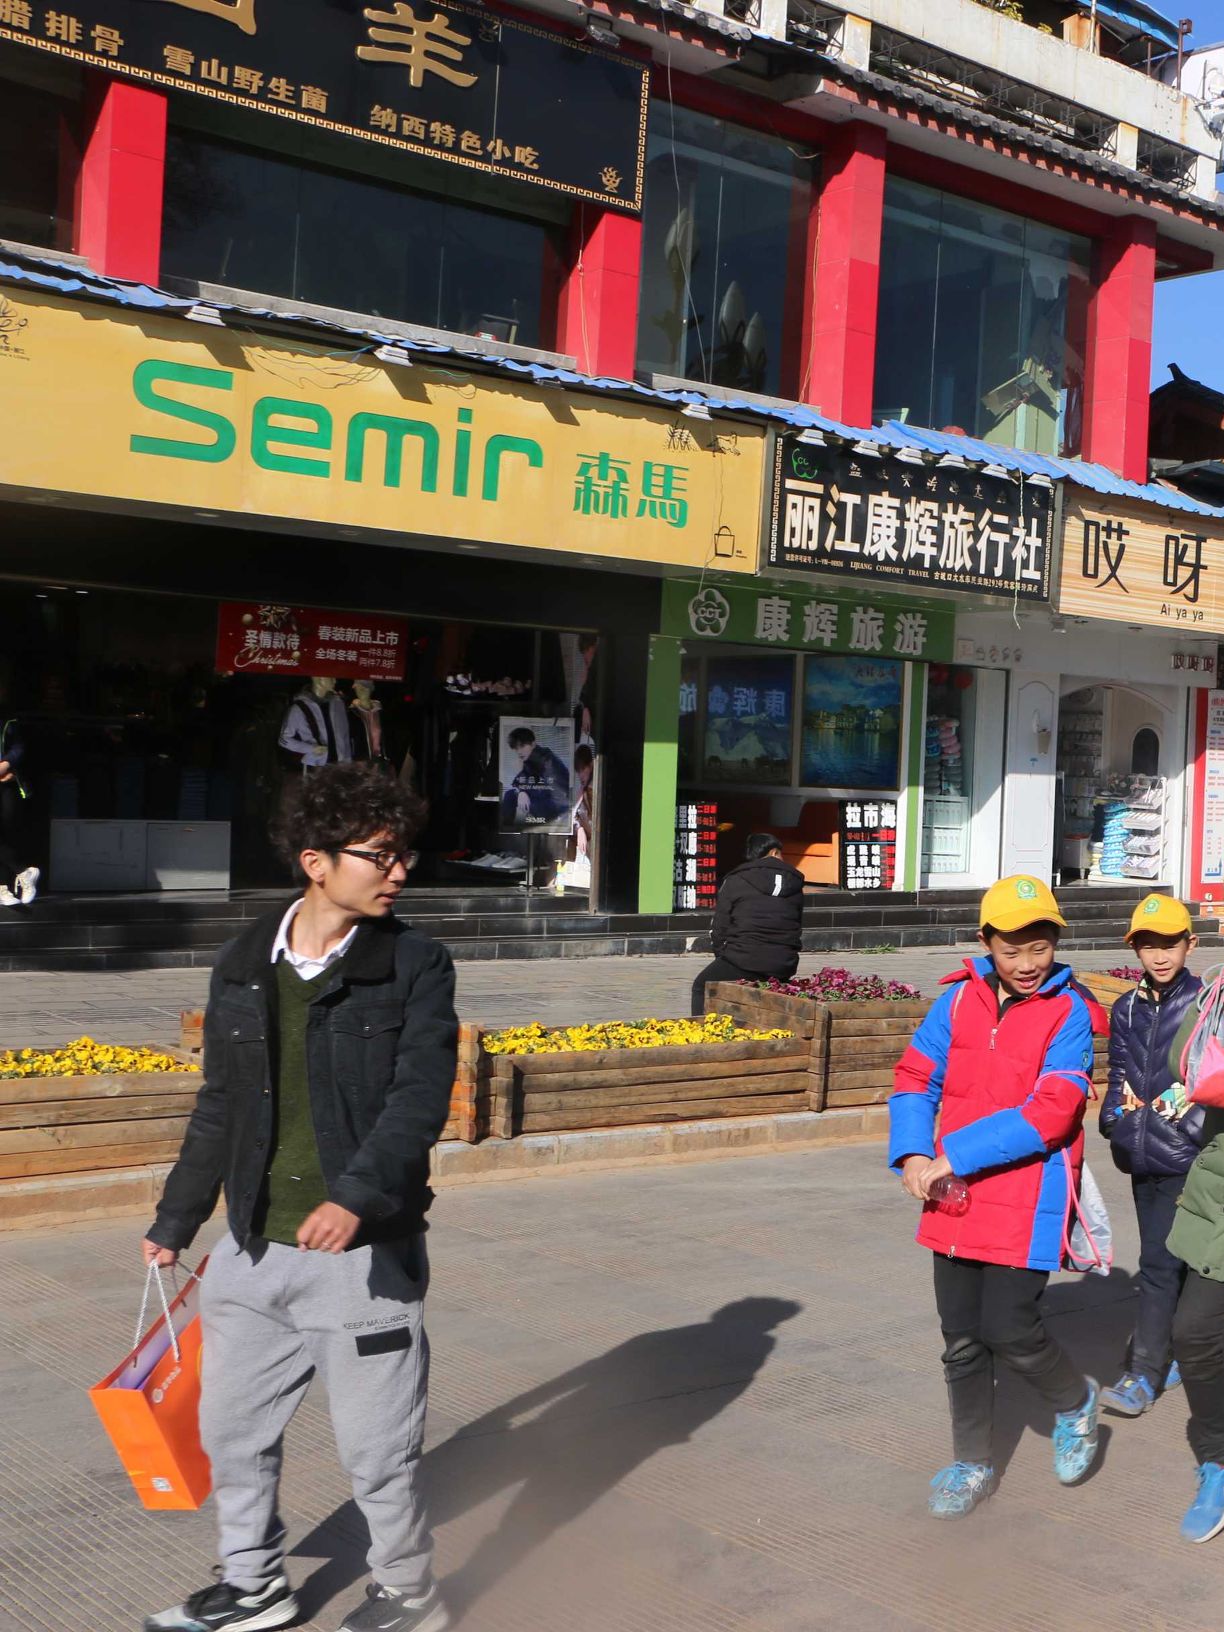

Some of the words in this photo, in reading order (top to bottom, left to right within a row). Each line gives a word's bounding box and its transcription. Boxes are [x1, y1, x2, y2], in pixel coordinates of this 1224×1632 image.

[163, 45, 329, 114] 雪山野生菌
[370, 104, 540, 169] 纳西特色小吃
[129, 357, 543, 502] Semir
[573, 451, 690, 528] 森馬
[784, 478, 1042, 580] 丽江康辉旅行社
[876, 564, 904, 575] COMFORT
[908, 569, 930, 578] TRAVEL
[754, 596, 928, 655] 康辉旅游
[1160, 604, 1171, 616] Ai
[1176, 608, 1188, 620] ya
[1192, 609, 1204, 621] ya
[318, 625, 399, 646] 春装新品上市
[315, 648, 358, 662] 全场冬装
[846, 802, 896, 828] 拉市海
[847, 867, 880, 878] 玉龙雪山
